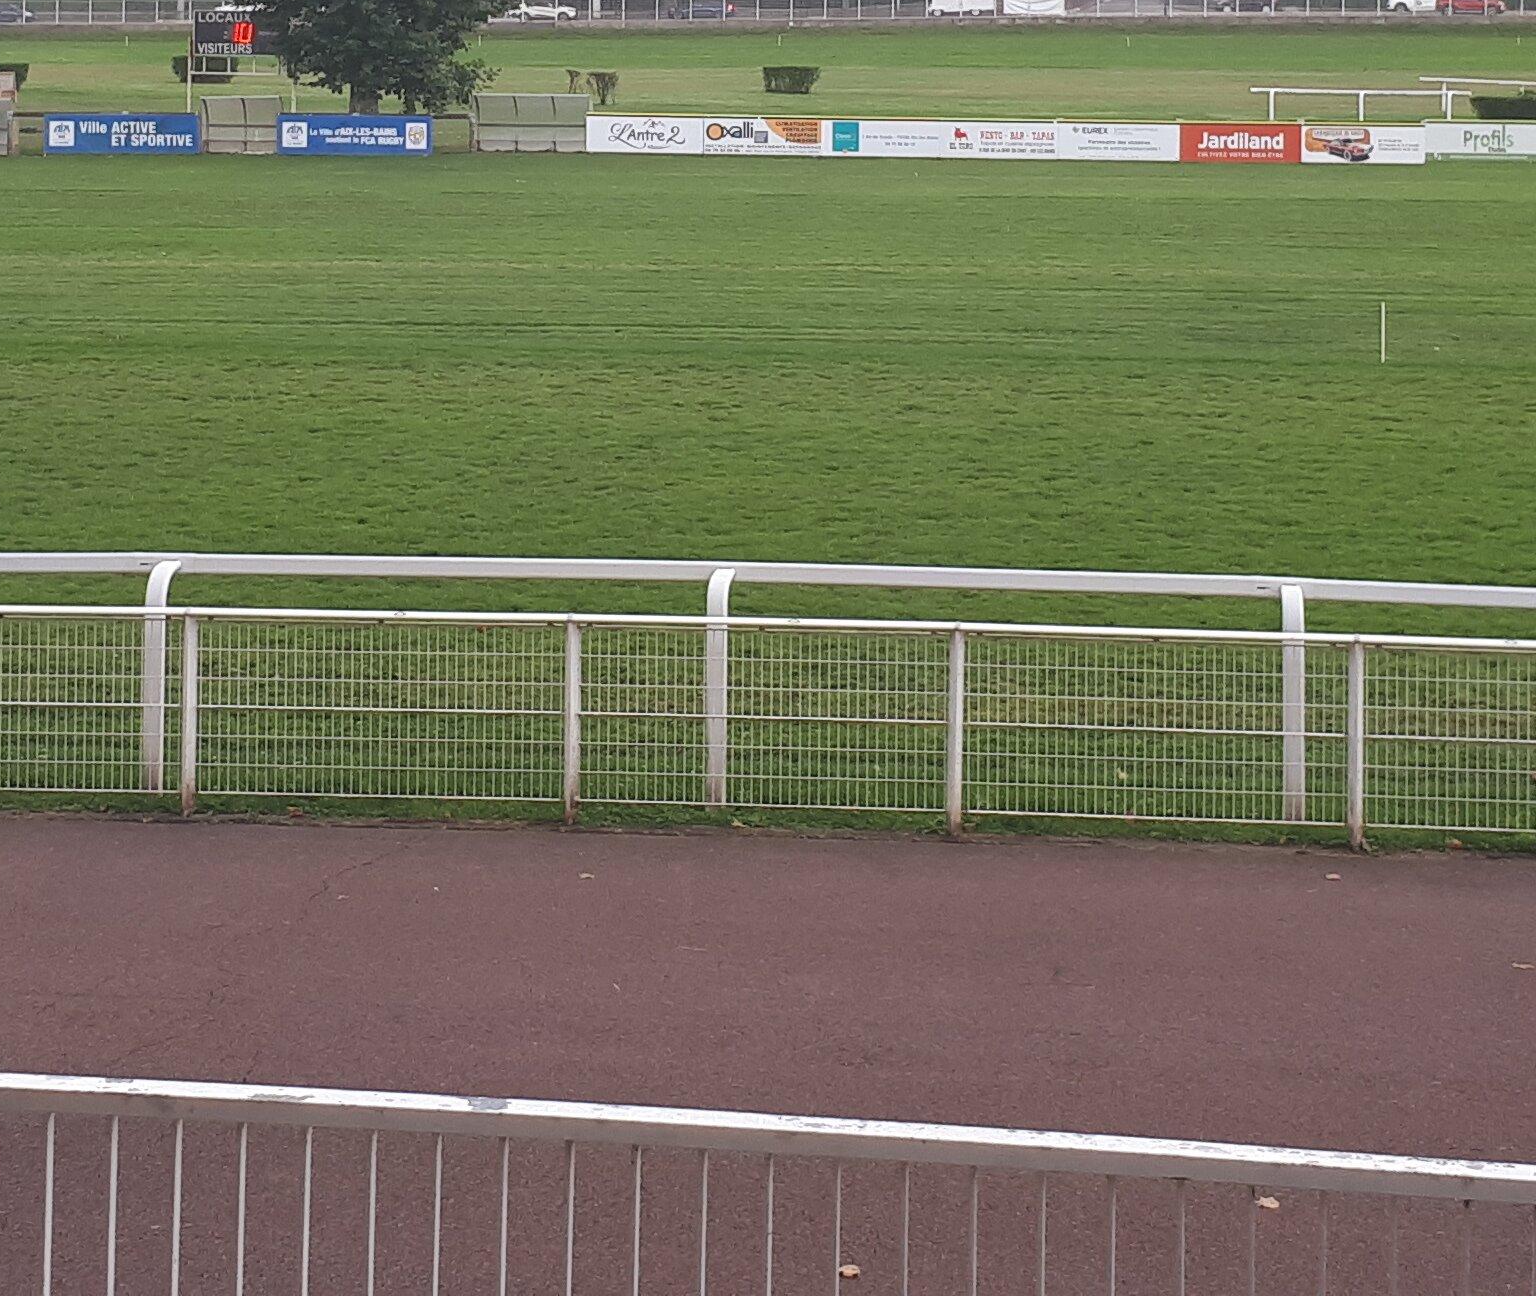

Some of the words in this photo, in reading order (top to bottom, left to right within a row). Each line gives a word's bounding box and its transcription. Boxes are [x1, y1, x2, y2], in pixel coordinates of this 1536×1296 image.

[197, 12, 252, 23] LOCAUX
[197, 43, 253, 55] VISITEURS
[79, 121, 107, 134] Ville
[112, 121, 156, 134] ACTIVE
[111, 135, 128, 147] ET
[131, 135, 193, 147] SPORTIVE
[378, 137, 404, 145] RUGBY
[1010, 132, 1025, 140] BAR
[1032, 132, 1055, 140] TAPAS
[1197, 132, 1284, 150] Jardiland
[1464, 125, 1514, 151] Profils
